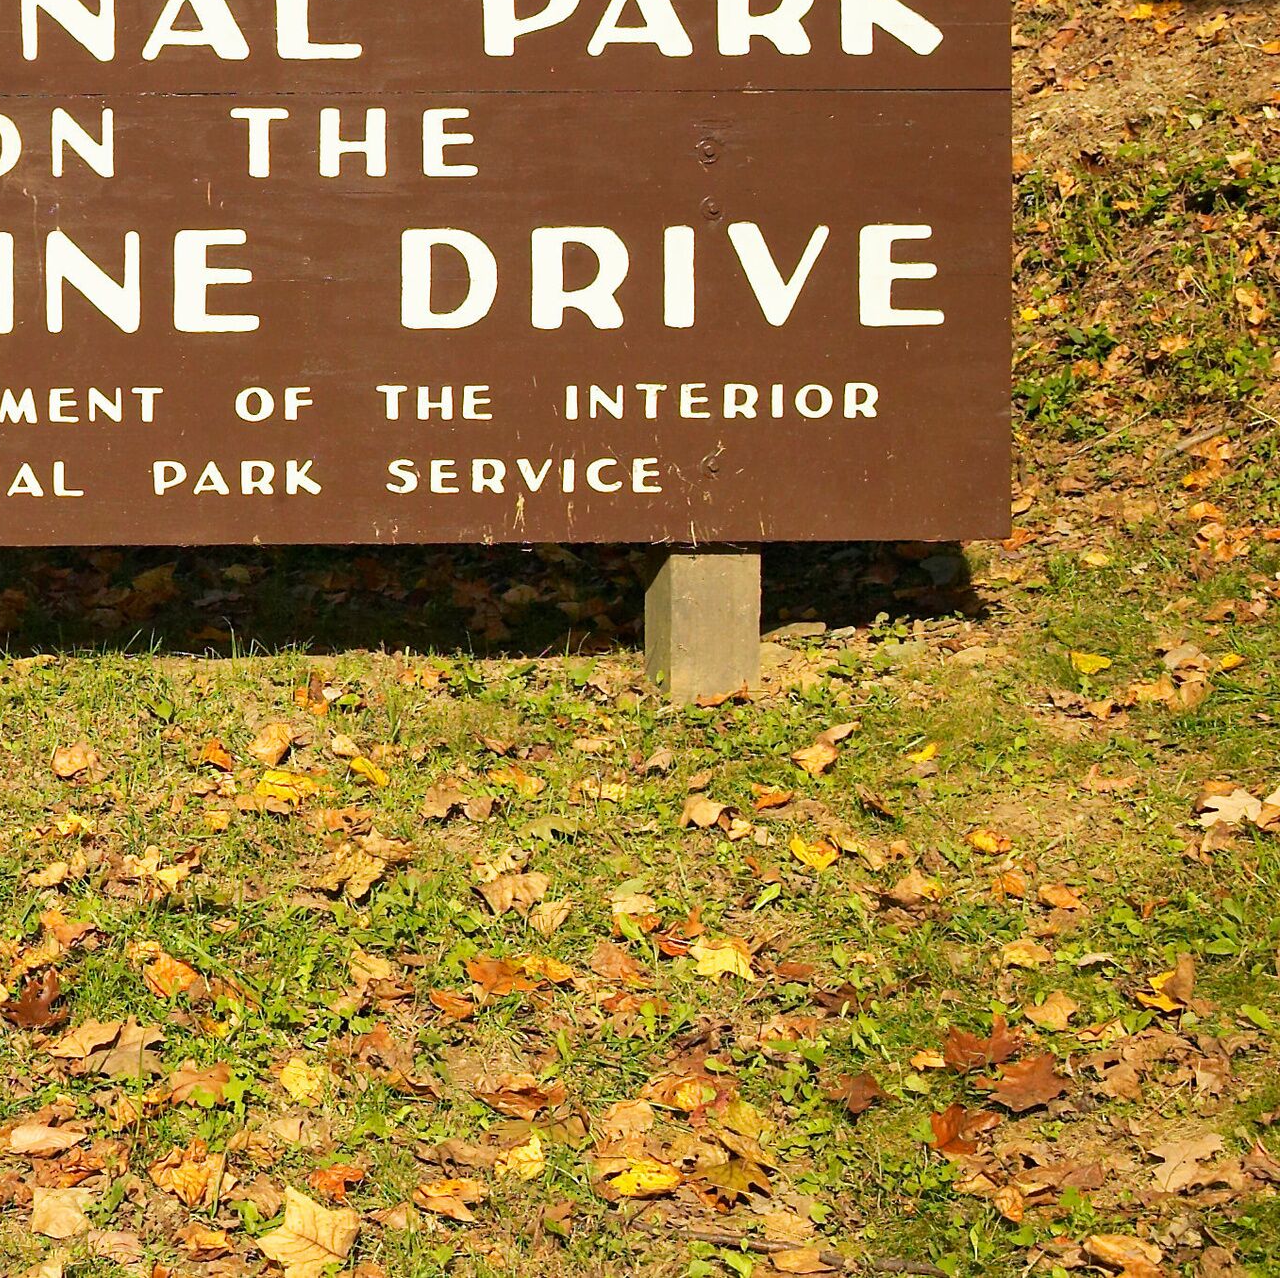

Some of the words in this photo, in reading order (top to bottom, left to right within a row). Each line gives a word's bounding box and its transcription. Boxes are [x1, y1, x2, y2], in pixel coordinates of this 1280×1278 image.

[230, 107, 479, 178] THE
[401, 221, 945, 330] DRIVE
[235, 386, 314, 422] OF
[375, 384, 493, 420] THE
[565, 382, 879, 420] INTERIOR
[153, 460, 322, 496] PARK
[386, 457, 663, 495] SERVICE
